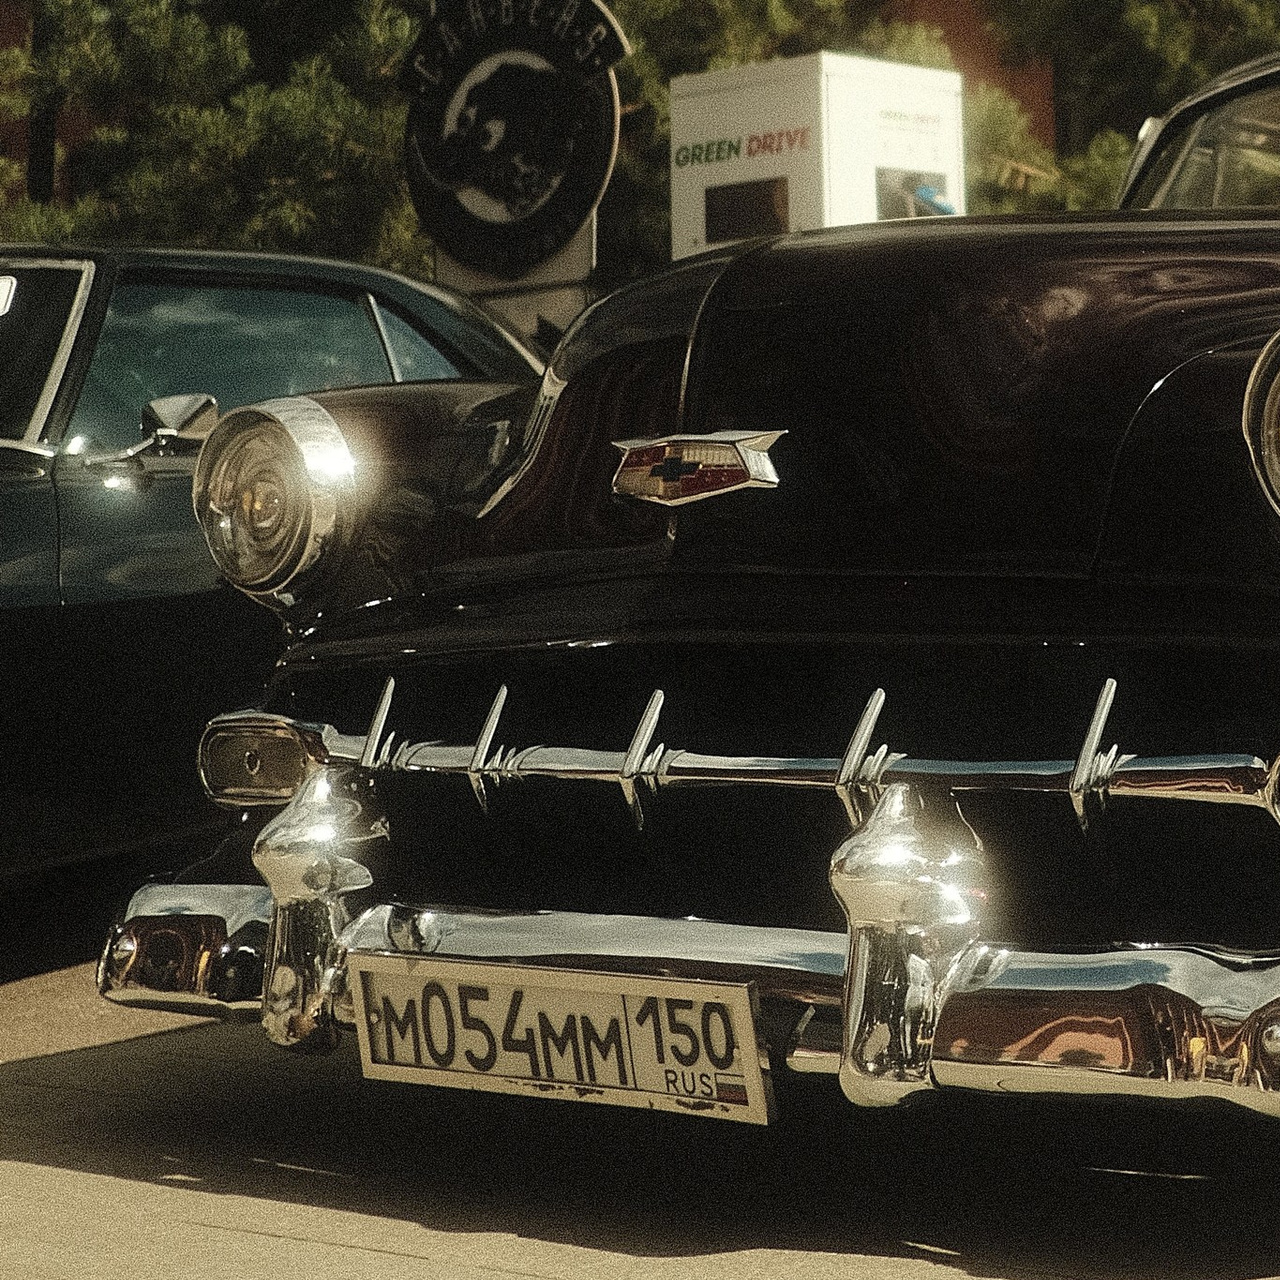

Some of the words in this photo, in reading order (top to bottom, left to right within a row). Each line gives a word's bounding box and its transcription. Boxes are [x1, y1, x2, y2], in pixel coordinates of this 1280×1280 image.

[675, 137, 742, 167] GREEN
[746, 127, 811, 157] DRIVE
[636, 996, 736, 1070] 150
[664, 1069, 716, 1098] RUS
